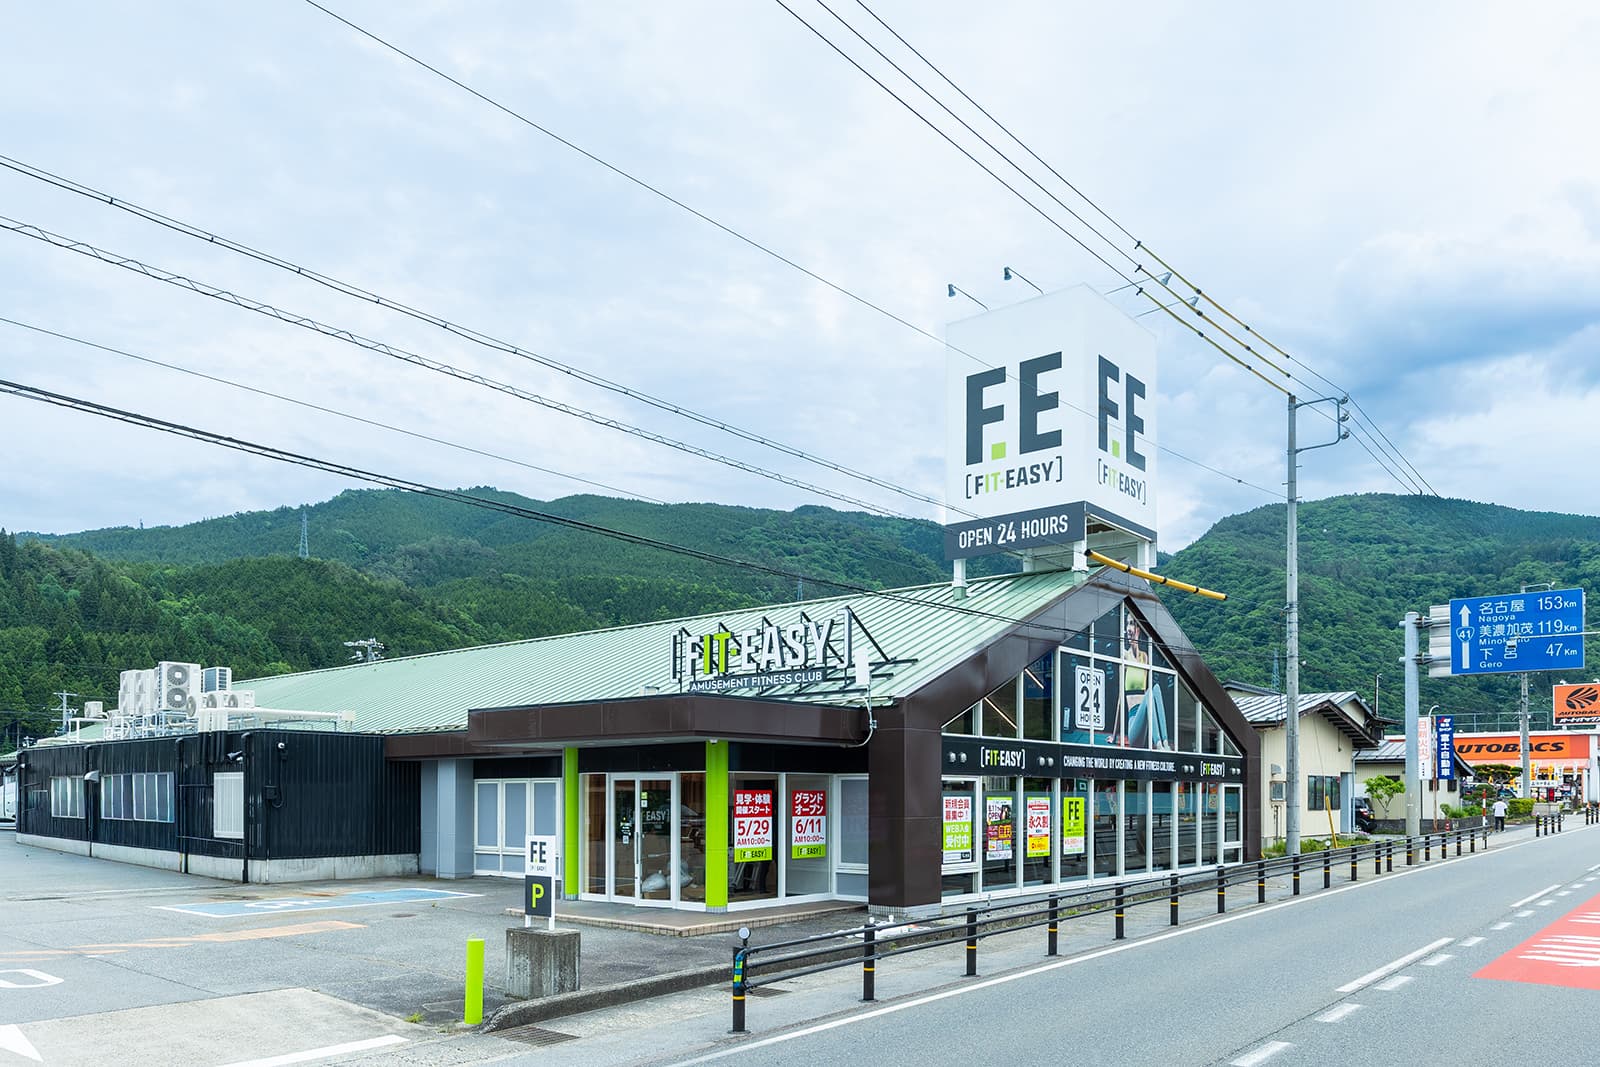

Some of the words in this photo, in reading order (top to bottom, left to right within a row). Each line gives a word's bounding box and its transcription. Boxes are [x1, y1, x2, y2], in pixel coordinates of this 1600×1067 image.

[958, 526, 993, 549] OPEN
[997, 521, 1017, 545] 24
[1021, 514, 1069, 539] HOURS
[1479, 599, 1525, 615] 名古屋
[1478, 614, 1516, 623] Nagoya
[1458, 630, 1472, 639] 41
[1479, 622, 1533, 638] 美濃加茂
[1479, 647, 1518, 660] 下呂
[1479, 661, 1503, 669] Gero
[690, 677, 749, 692] AMUSEMENT
[751, 673, 792, 687] FITNESS
[795, 671, 822, 683] CLUB
[1080, 686, 1101, 713] 24
[1080, 713, 1101, 724] HORS
[1454, 742, 1565, 754] UTOBCS
[1063, 755, 1085, 768] CHANGING
[1086, 757, 1094, 768] THE
[1094, 757, 1108, 769] WORLD
[1109, 758, 1114, 769] BY
[1115, 758, 1133, 770] CREATING
[1137, 760, 1145, 770] NEW
[1146, 760, 1159, 770] FITNESS
[794, 792, 824, 804] グランド
[794, 804, 824, 815] オープン
[737, 819, 769, 836] 5/29
[795, 818, 822, 834] 6/11
[945, 835, 969, 848] 受付中
[532, 883, 545, 908] P
